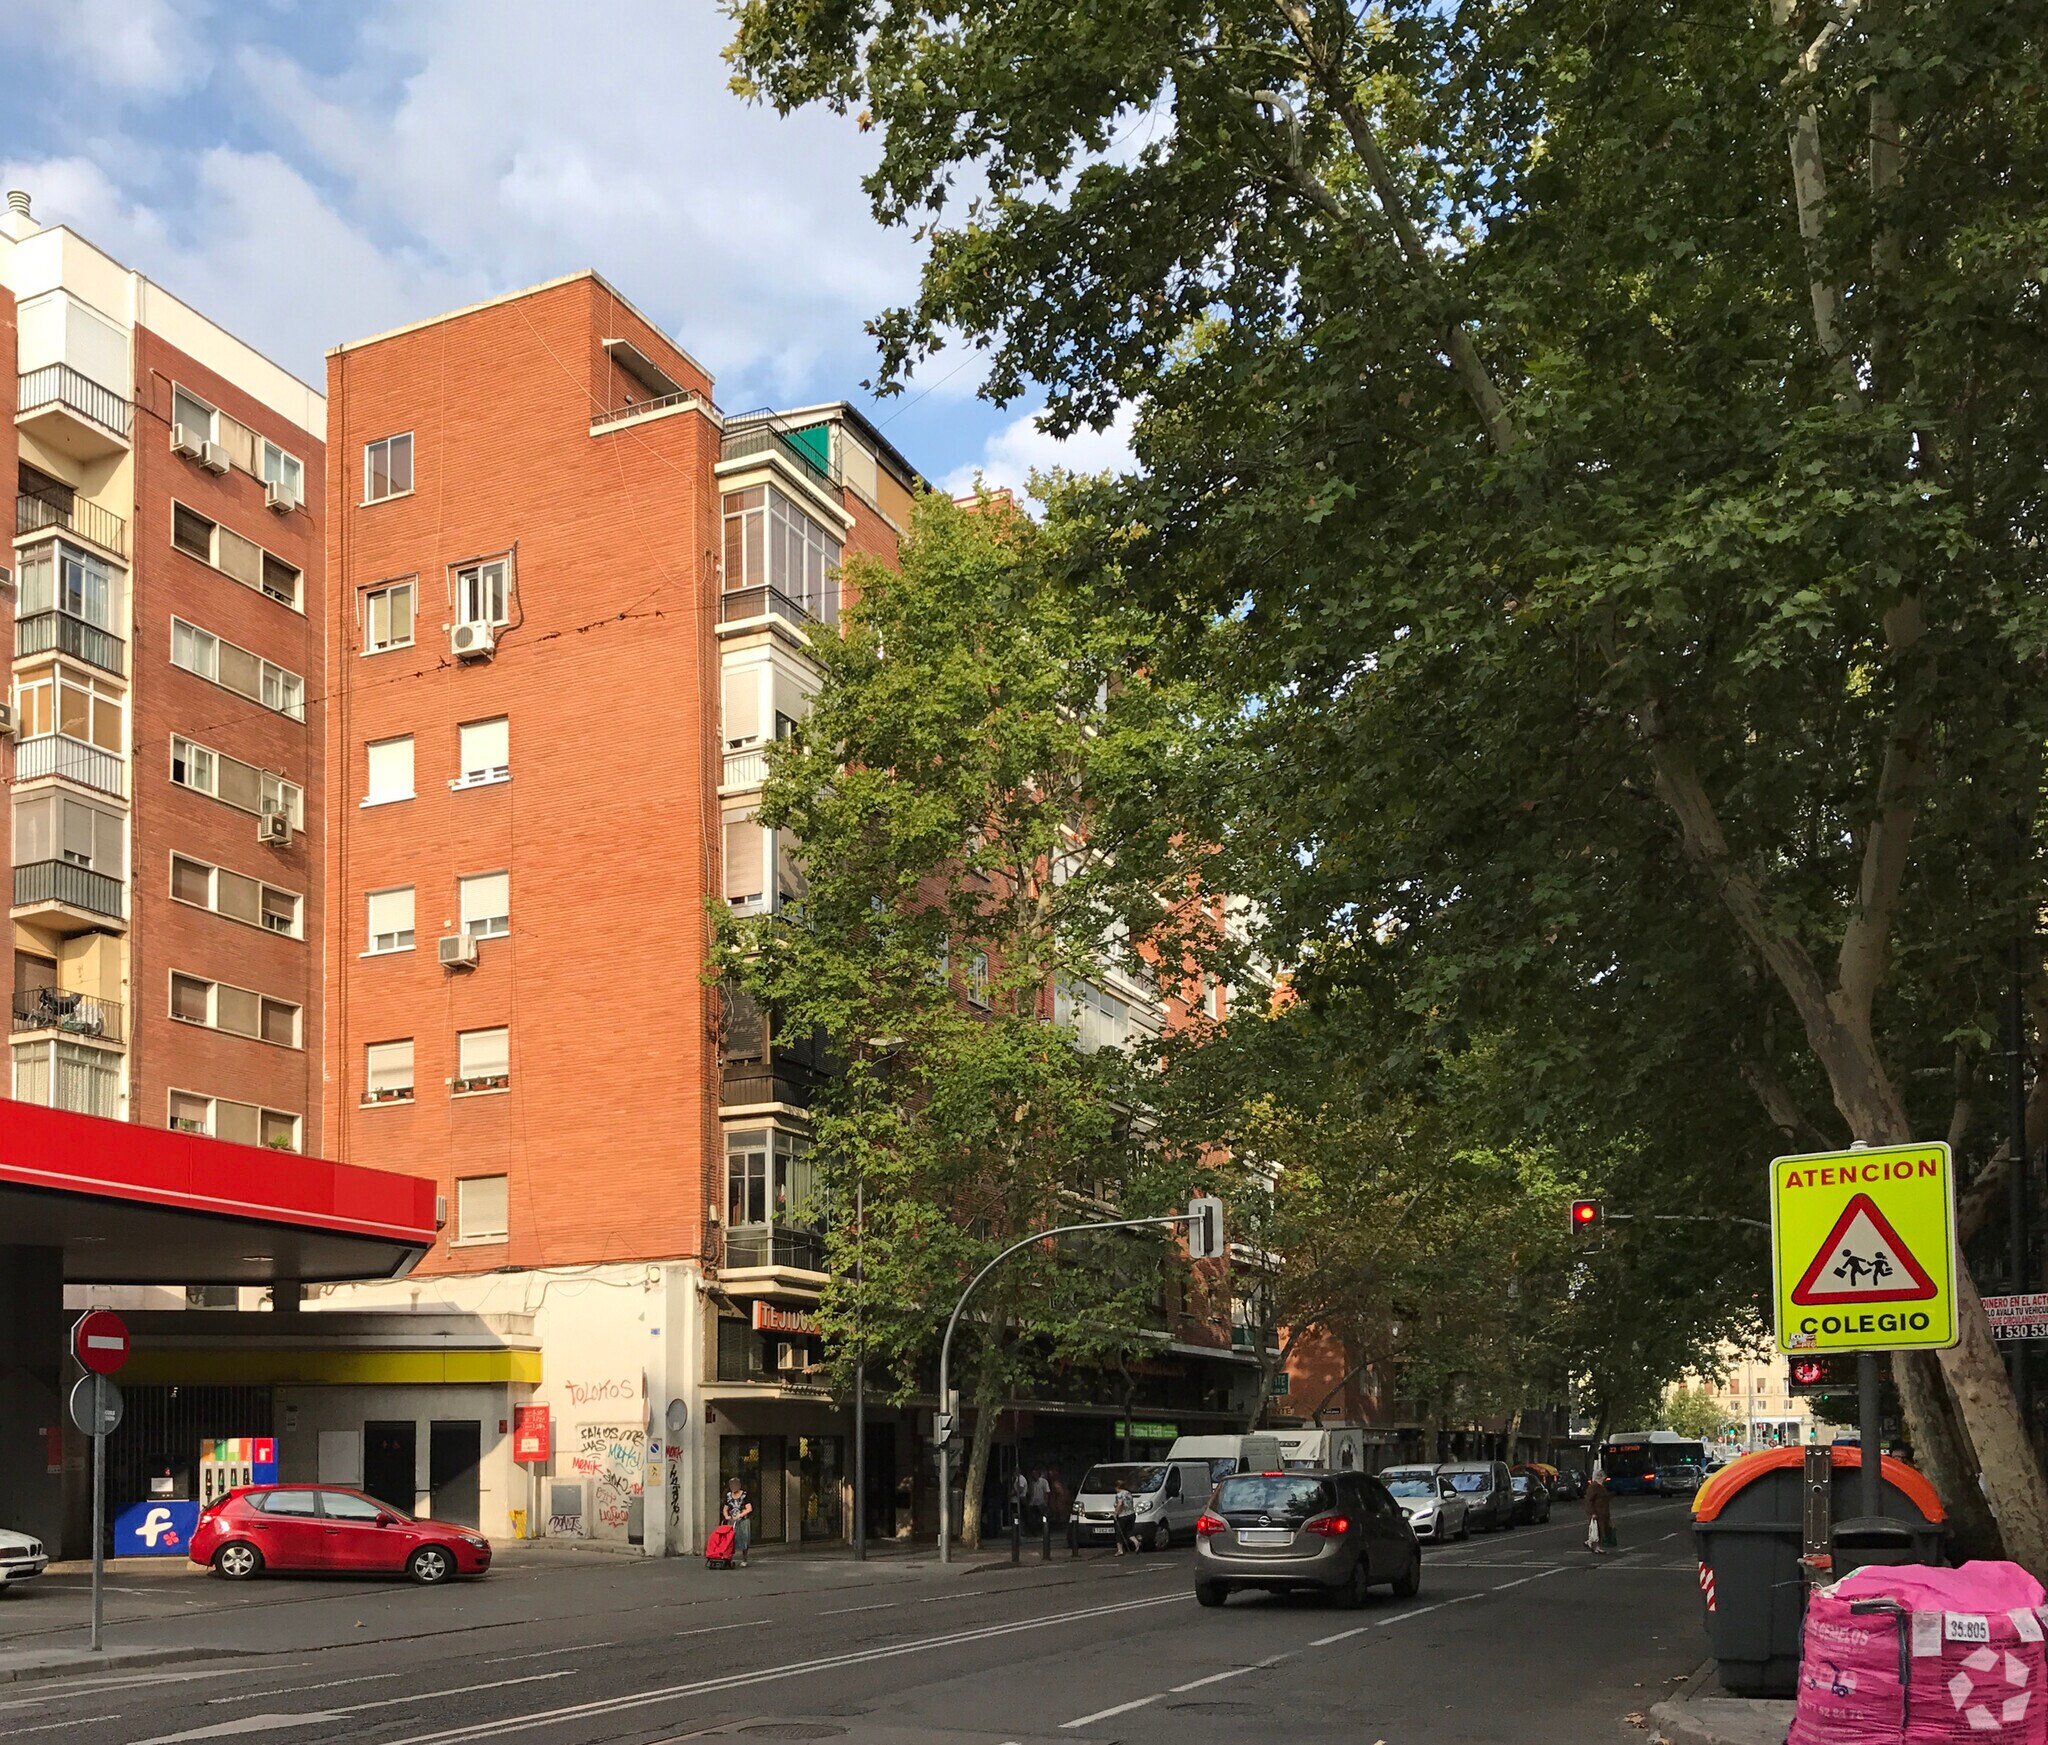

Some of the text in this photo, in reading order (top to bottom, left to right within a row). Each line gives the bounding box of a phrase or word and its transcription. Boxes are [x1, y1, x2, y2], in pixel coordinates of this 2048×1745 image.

[1785, 1159, 1937, 1189] ATENCION
[1981, 1295, 2048, 1310] DINERO EN EL ACT
[1996, 1308, 2014, 1316] AVALA
[2015, 1307, 2024, 1316] TU
[1800, 1312, 1930, 1335] COLEGIO
[2005, 1325, 2028, 1338] 530
[1950, 1620, 1987, 1639] 35.805
